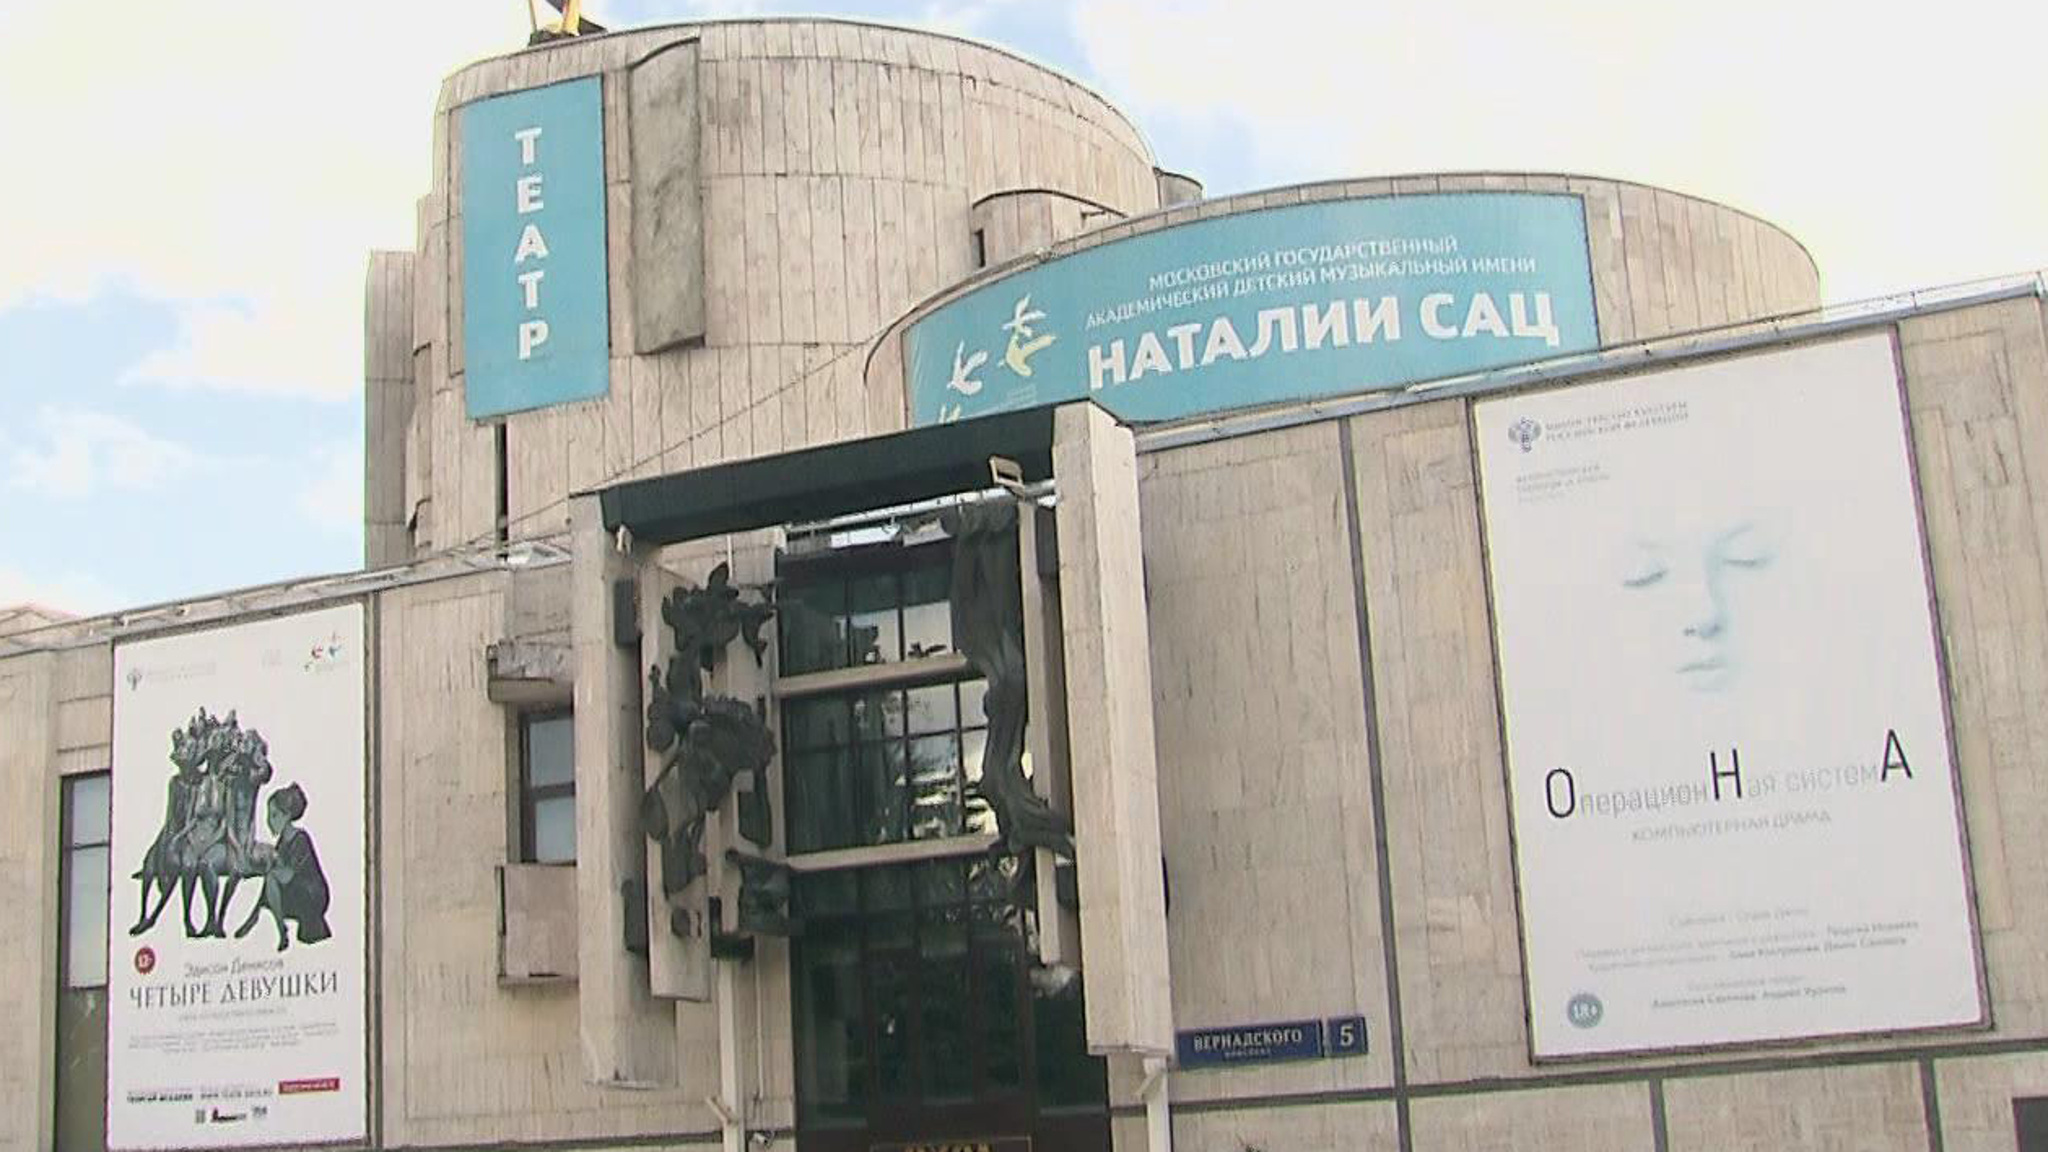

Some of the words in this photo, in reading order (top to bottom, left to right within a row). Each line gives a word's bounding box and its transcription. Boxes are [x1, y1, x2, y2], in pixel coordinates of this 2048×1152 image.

[514, 127, 549, 361] ТЕАТР
[1149, 252, 1271, 291] МОСКОВСКИЙ
[1275, 235, 1458, 266] ГОСУДАРСТВЕННЫЙ
[1085, 282, 1229, 330] АКАДЕМИЧЕСКИЙ
[1233, 268, 1317, 298] ДЕТСКИЙ
[1320, 257, 1468, 284] МУЗЫКАЛЬНЫЙ
[1472, 255, 1536, 274] ИМЕНИ
[1088, 296, 1401, 391] НАТАЛИИ
[1419, 292, 1560, 348] САЦ
[129, 980, 213, 1009] ЧЕТЫРЕ
[220, 971, 339, 1004] ДЕВУШКИ
[1194, 1028, 1303, 1052] ВЕРНАДСКОГО
[1339, 1023, 1354, 1047] 5
